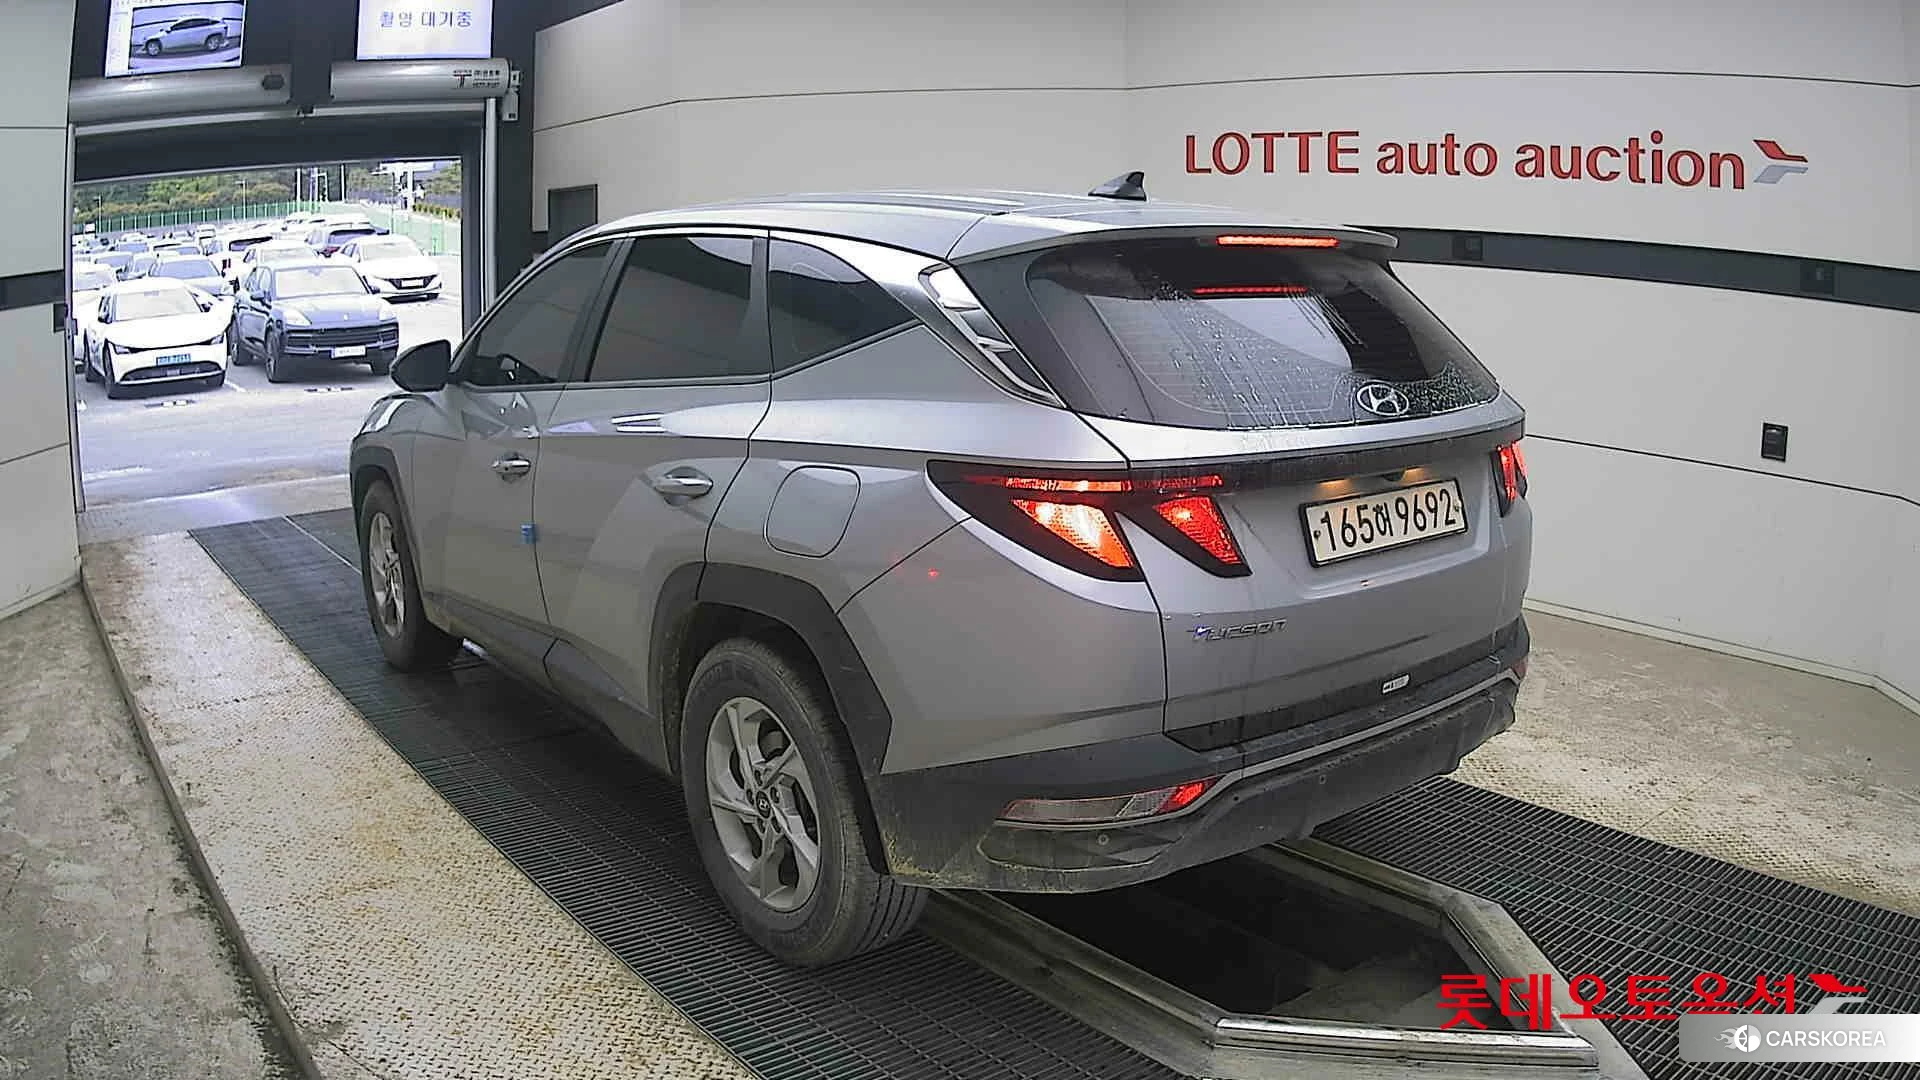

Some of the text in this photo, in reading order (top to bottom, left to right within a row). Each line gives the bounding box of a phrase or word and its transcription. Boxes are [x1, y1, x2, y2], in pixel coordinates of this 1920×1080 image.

[420, 11, 472, 28] 대기중
[1185, 130, 1745, 190] LOTTE auto auction
